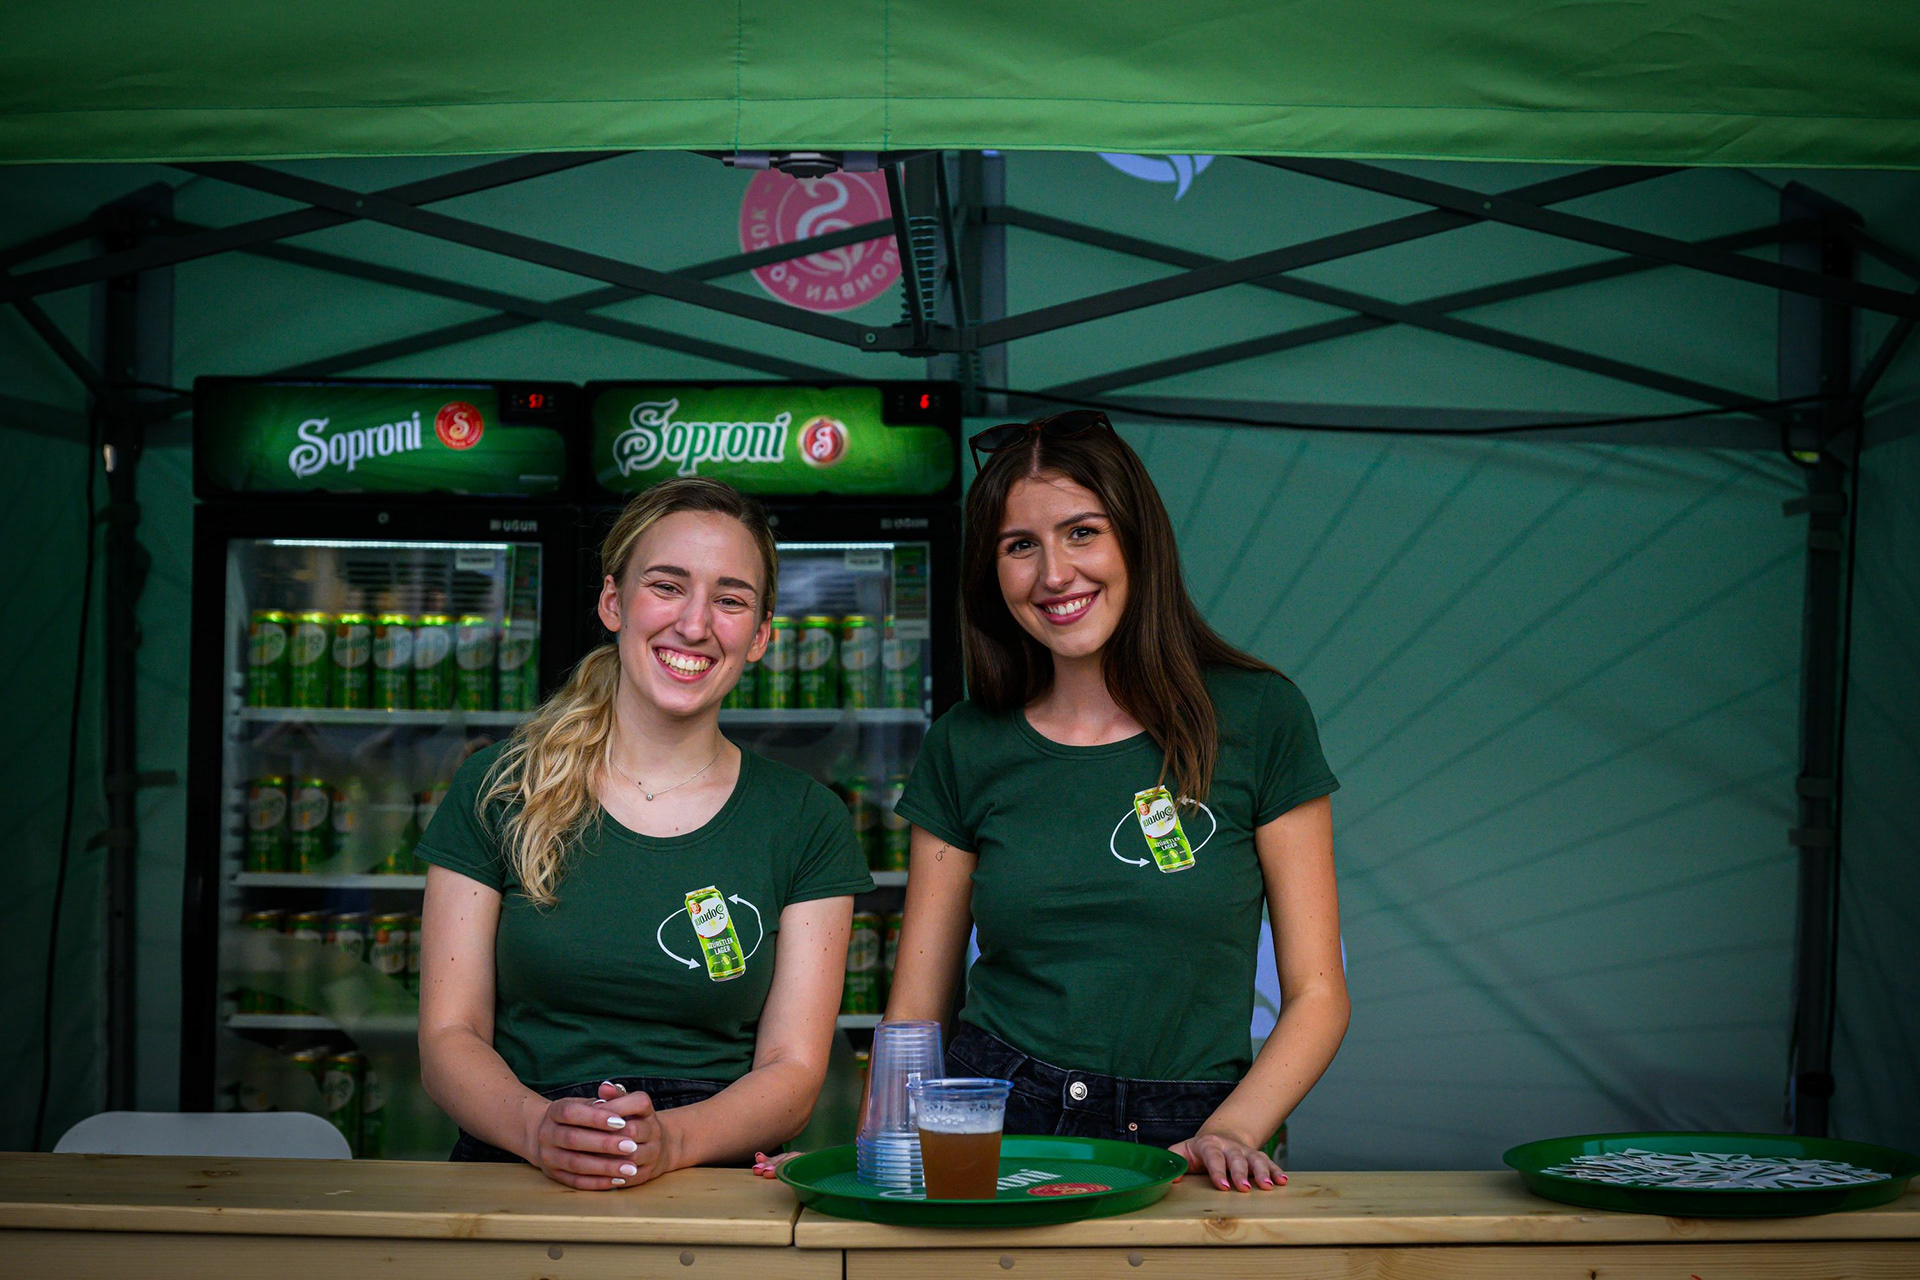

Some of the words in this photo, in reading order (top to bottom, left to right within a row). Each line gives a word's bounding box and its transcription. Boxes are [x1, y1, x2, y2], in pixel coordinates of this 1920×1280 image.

[288, 410, 422, 479] Soproni
[613, 397, 792, 477] Soproni
[713, 945, 731, 955] LAGER
